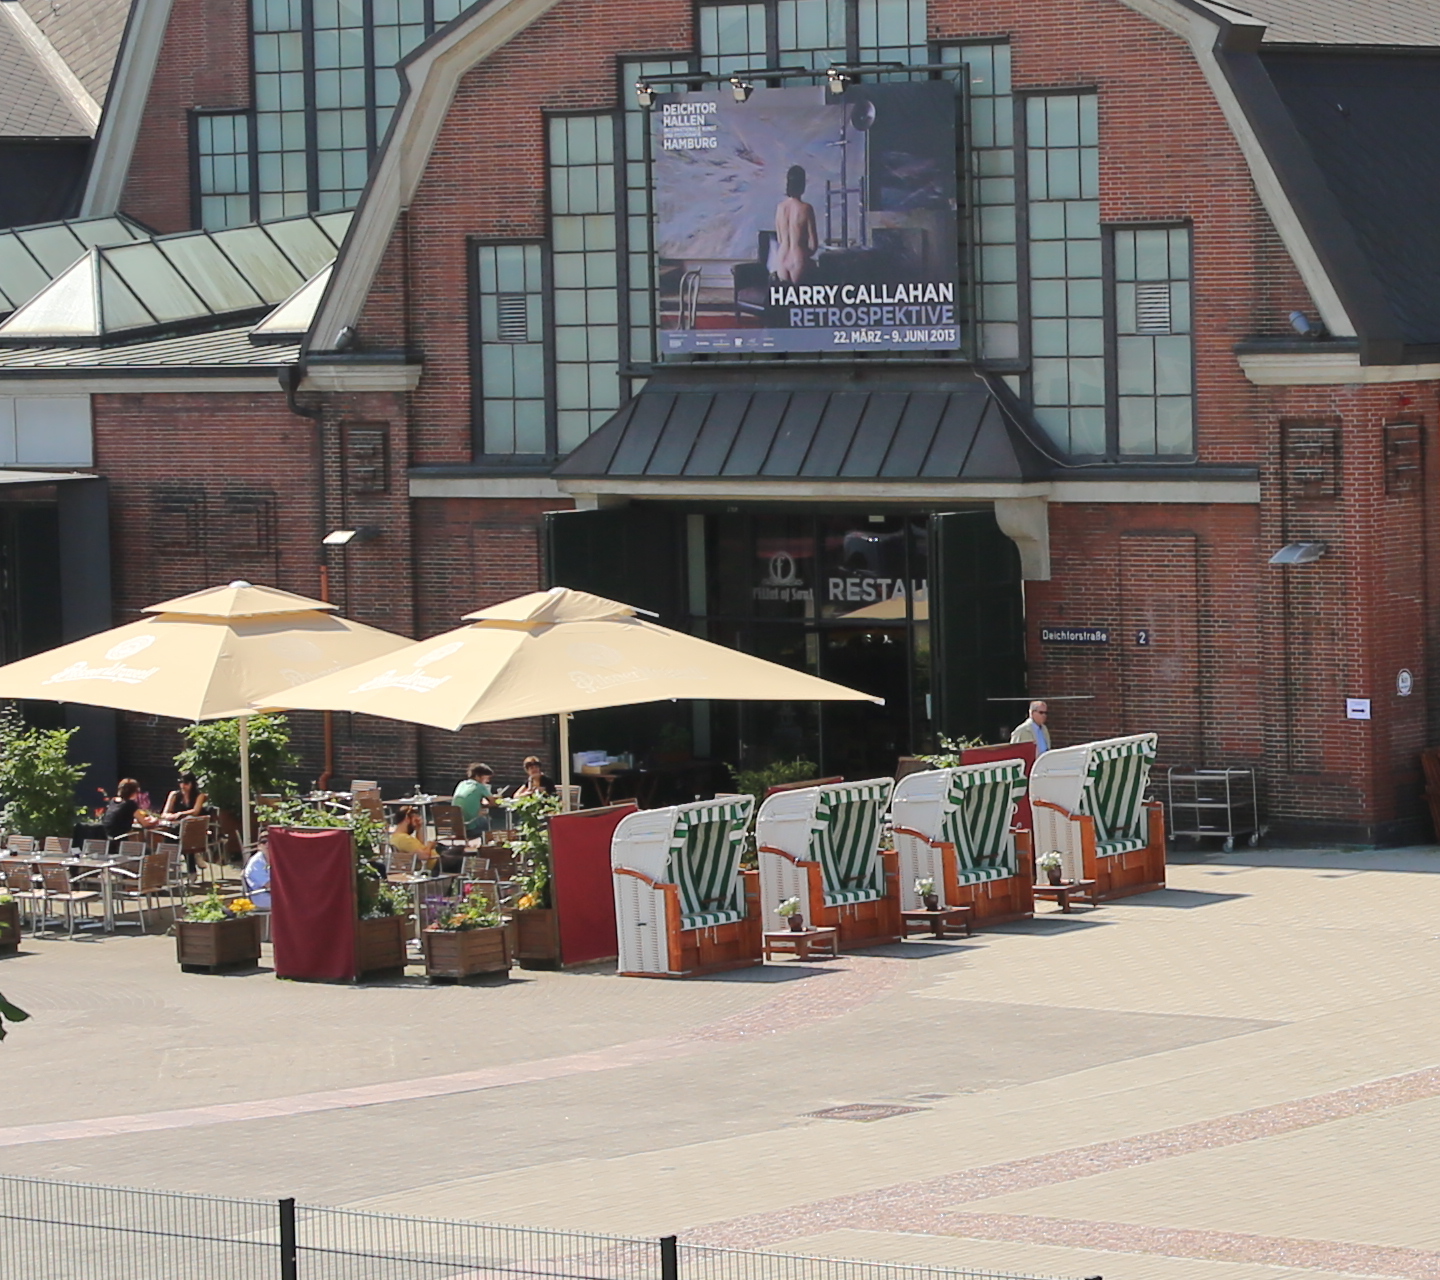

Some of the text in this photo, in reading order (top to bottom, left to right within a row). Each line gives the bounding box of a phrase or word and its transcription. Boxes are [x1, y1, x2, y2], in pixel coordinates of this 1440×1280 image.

[663, 102, 717, 115] DEICHTOR
[663, 115, 705, 127] HALLEN
[663, 137, 718, 150] HAMBURG
[770, 282, 954, 306] HARRY CALLAHAN
[790, 305, 955, 327] RETROSPEKTIVE
[833, 330, 850, 344] 22.
[851, 328, 882, 343] MÄRZ
[891, 330, 902, 343] 9.
[903, 330, 929, 343] JUNI
[930, 329, 955, 342] 2013
[1042, 629, 1107, 641] Deichtorstraße
[1138, 631, 1146, 644] 2
